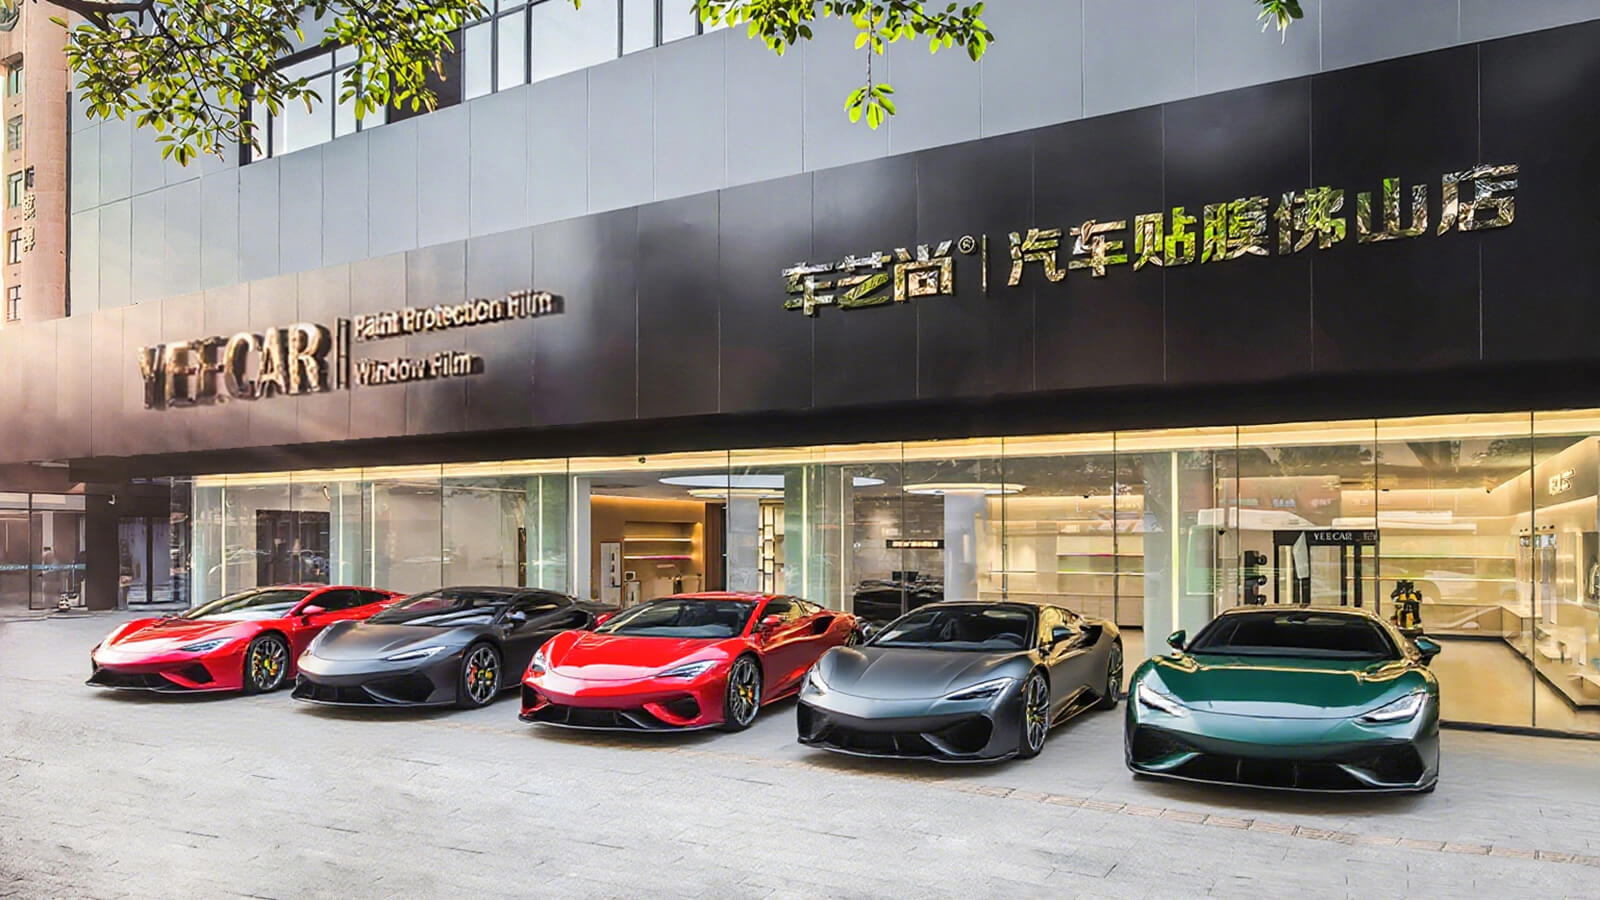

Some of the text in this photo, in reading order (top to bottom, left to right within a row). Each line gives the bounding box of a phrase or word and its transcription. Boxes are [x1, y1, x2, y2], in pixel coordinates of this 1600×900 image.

[1007, 163, 1519, 287] 汽车贴膜佛山店
[354, 289, 555, 340] Paint Protection Film
[354, 351, 473, 386] Window Film
